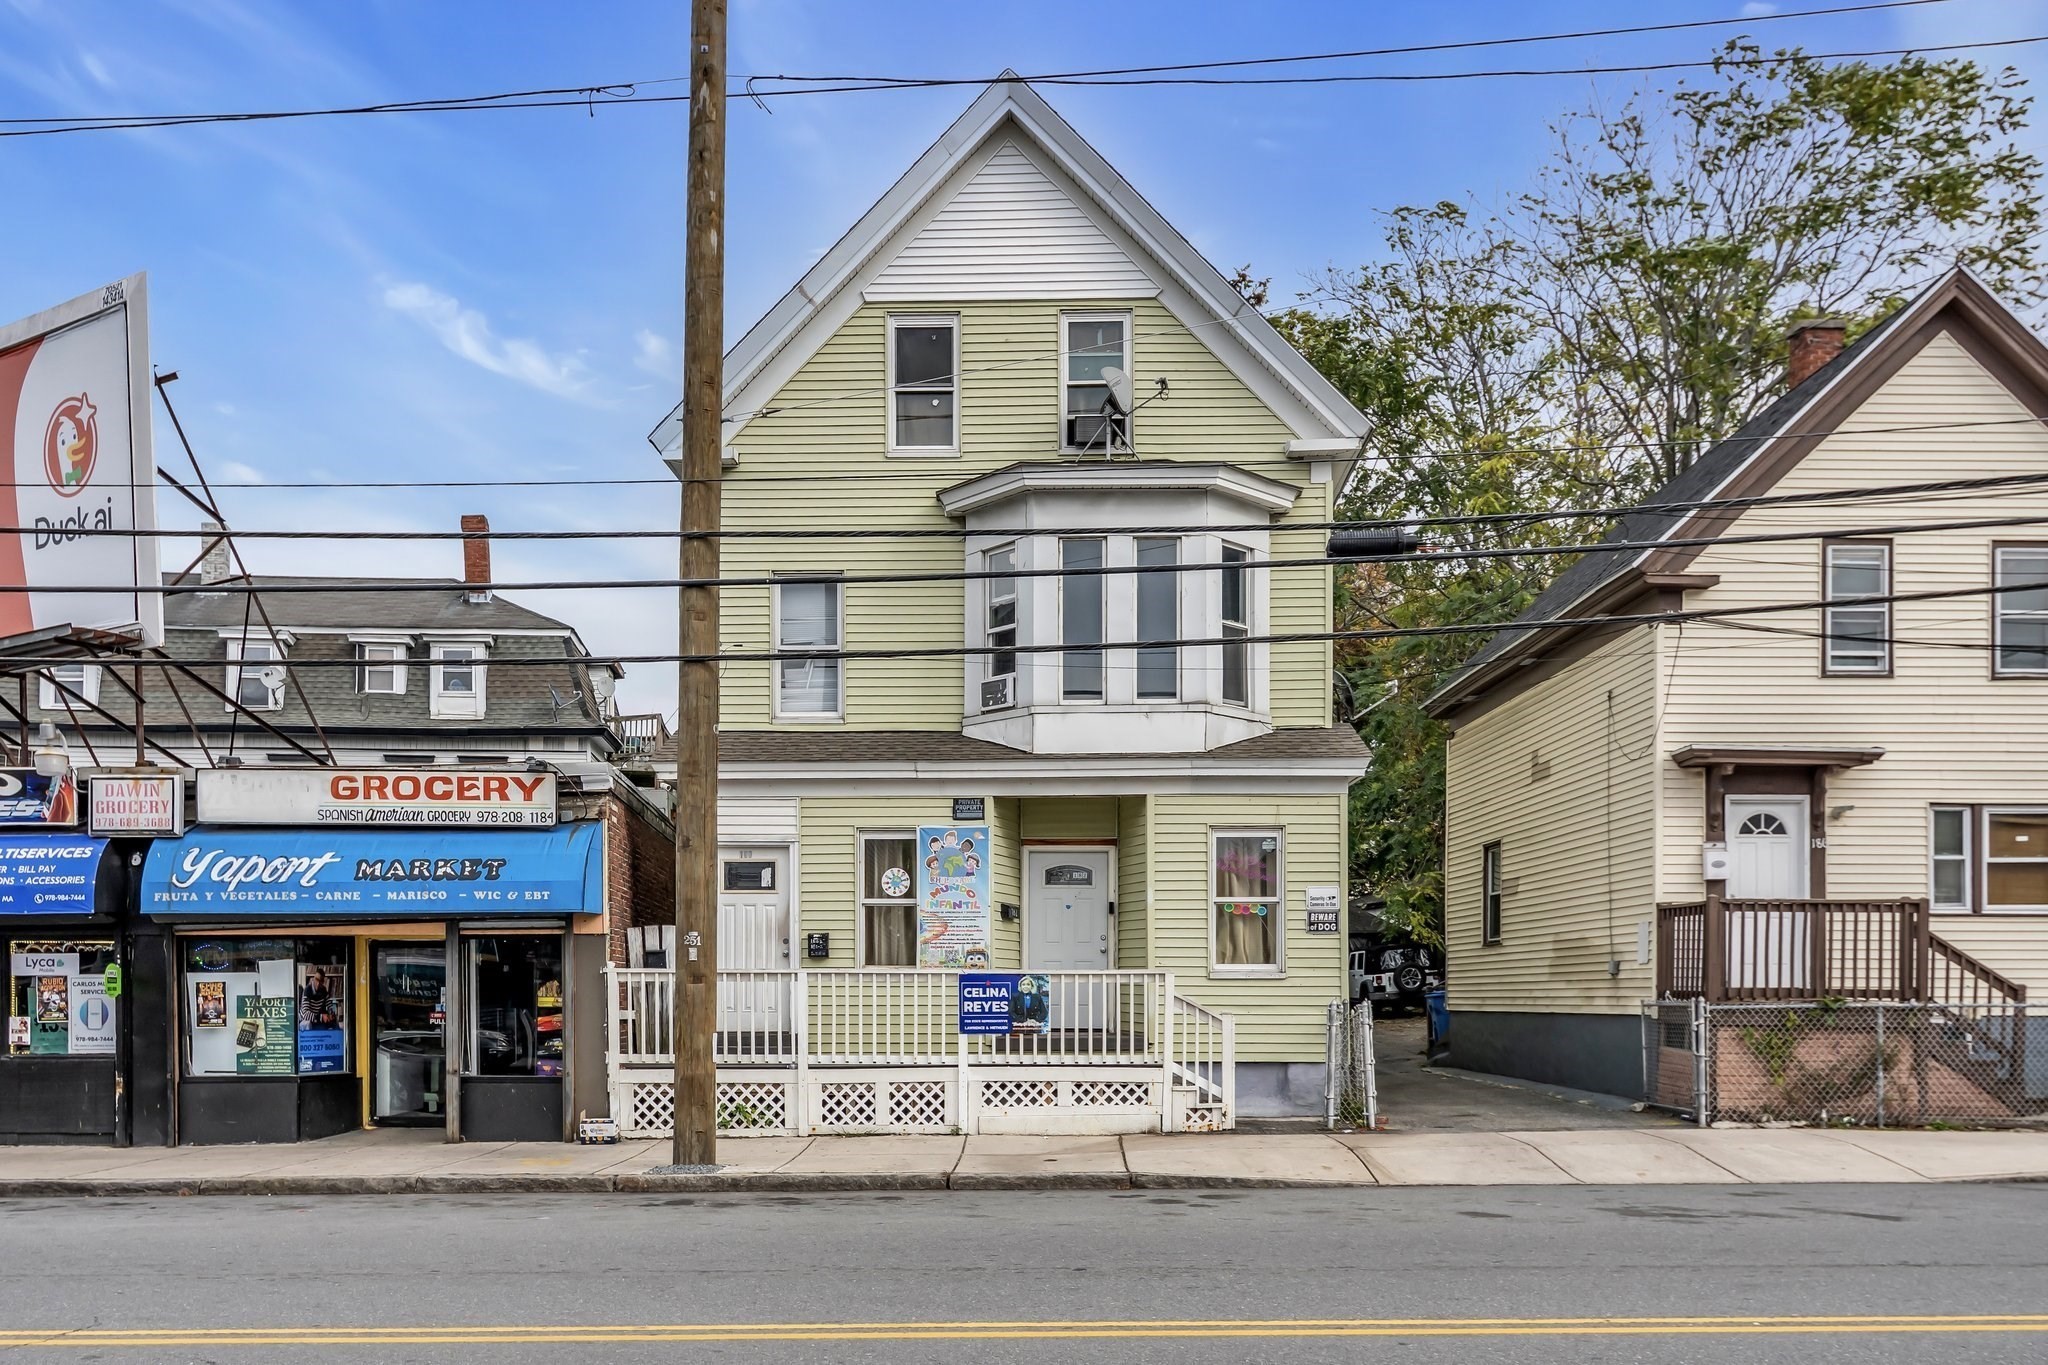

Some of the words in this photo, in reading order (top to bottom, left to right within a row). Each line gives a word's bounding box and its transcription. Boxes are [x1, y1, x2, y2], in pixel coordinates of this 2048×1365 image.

[105, 784, 160, 797] DAWIN
[330, 775, 546, 801] GROCERY
[95, 800, 169, 814] GROCERY
[317, 809, 364, 821] SPANISH
[364, 806, 425, 822] american
[427, 810, 471, 822] GROCERY
[95, 818, 170, 827] 978-689-3688
[18, 865, 36, 874] BILL
[38, 865, 57, 873] PAY
[172, 847, 342, 892] Yaport
[354, 858, 507, 881] MARKET
[25, 876, 86, 885] ACCESSORIES
[154, 892, 198, 901] FRUTA
[205, 892, 214, 900] Y
[220, 891, 297, 901] VEGETALES
[315, 891, 361, 901] CARNE
[387, 891, 447, 900] MARISCO
[474, 891, 501, 900] WIC
[507, 892, 518, 900] &
[525, 891, 550, 900] EBT
[929, 884, 976, 899] MUNDO
[926, 900, 981, 910] INFANTIL
[1311, 913, 1336, 921] BEWARE
[684, 935, 701, 946] 251
[25, 956, 55, 969] Lyca
[964, 988, 1008, 998] CELINA
[245, 998, 287, 1007] YAPORT
[964, 1001, 1009, 1012] REYES
[244, 1008, 287, 1018] TAXES
